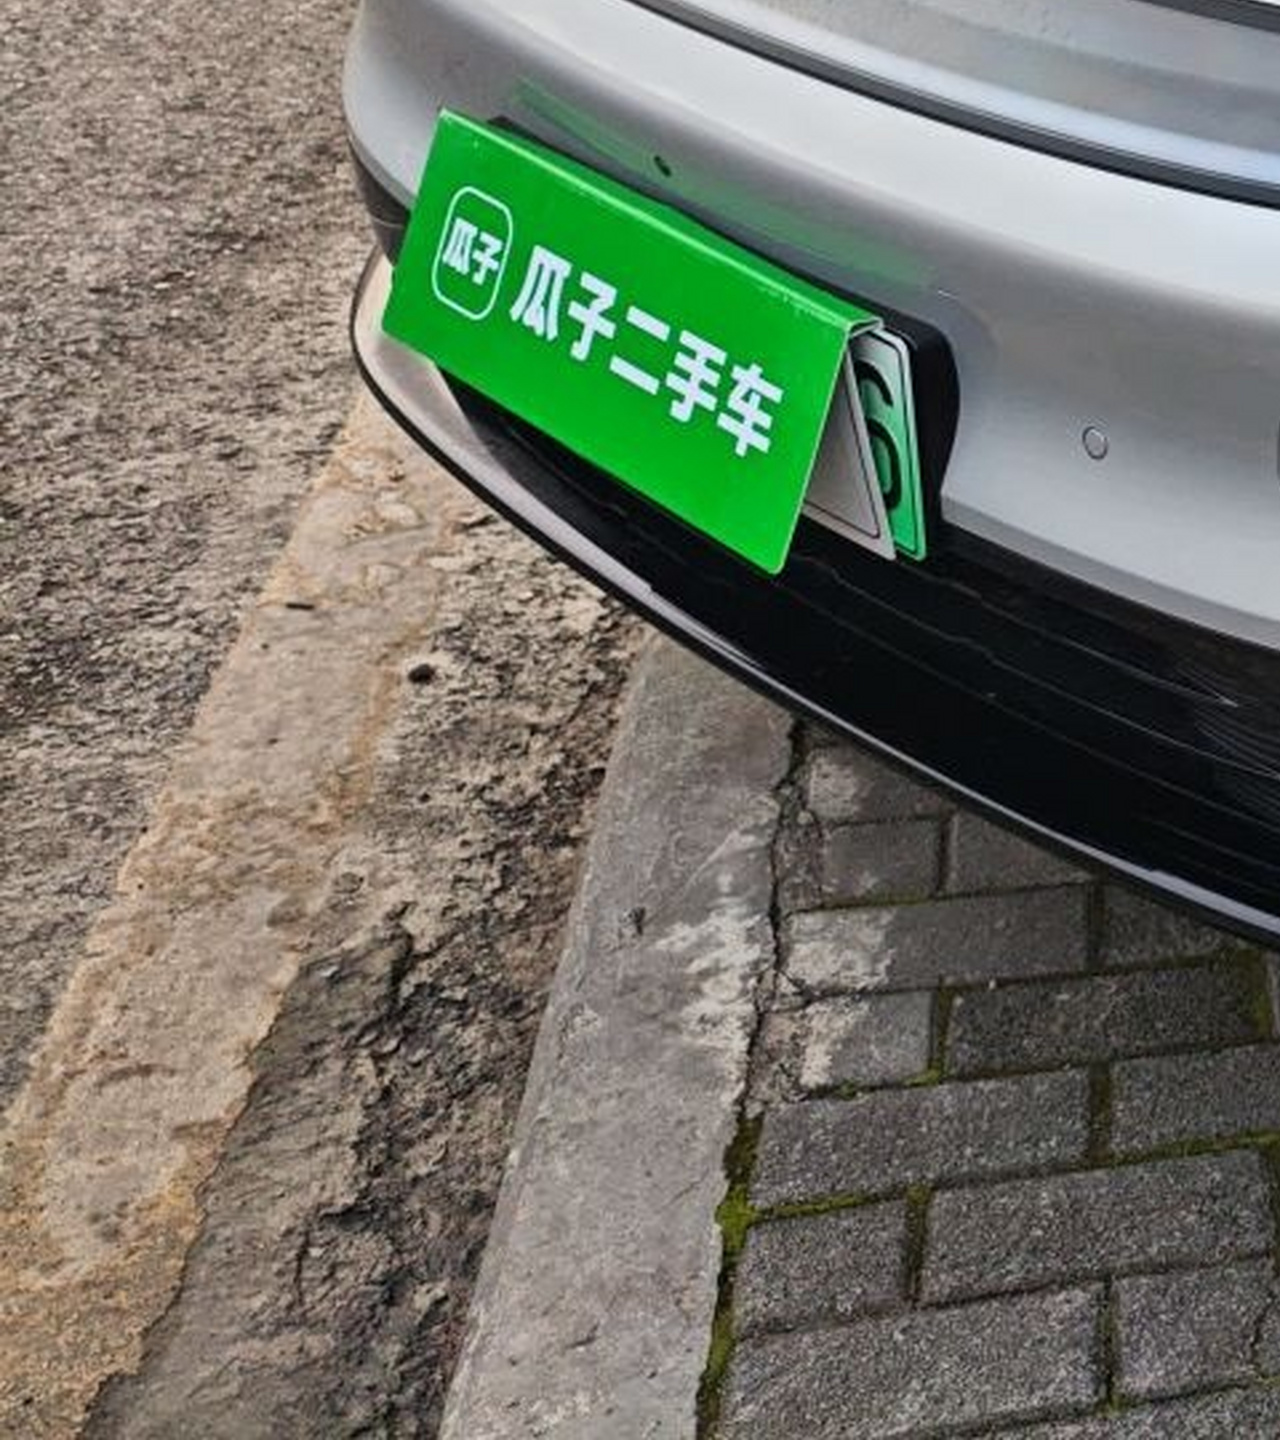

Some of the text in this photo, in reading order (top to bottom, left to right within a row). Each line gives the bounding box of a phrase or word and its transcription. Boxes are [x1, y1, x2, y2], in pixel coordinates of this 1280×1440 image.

[443, 216, 505, 286] 瓜子
[509, 244, 784, 458] 瓜子二手车
